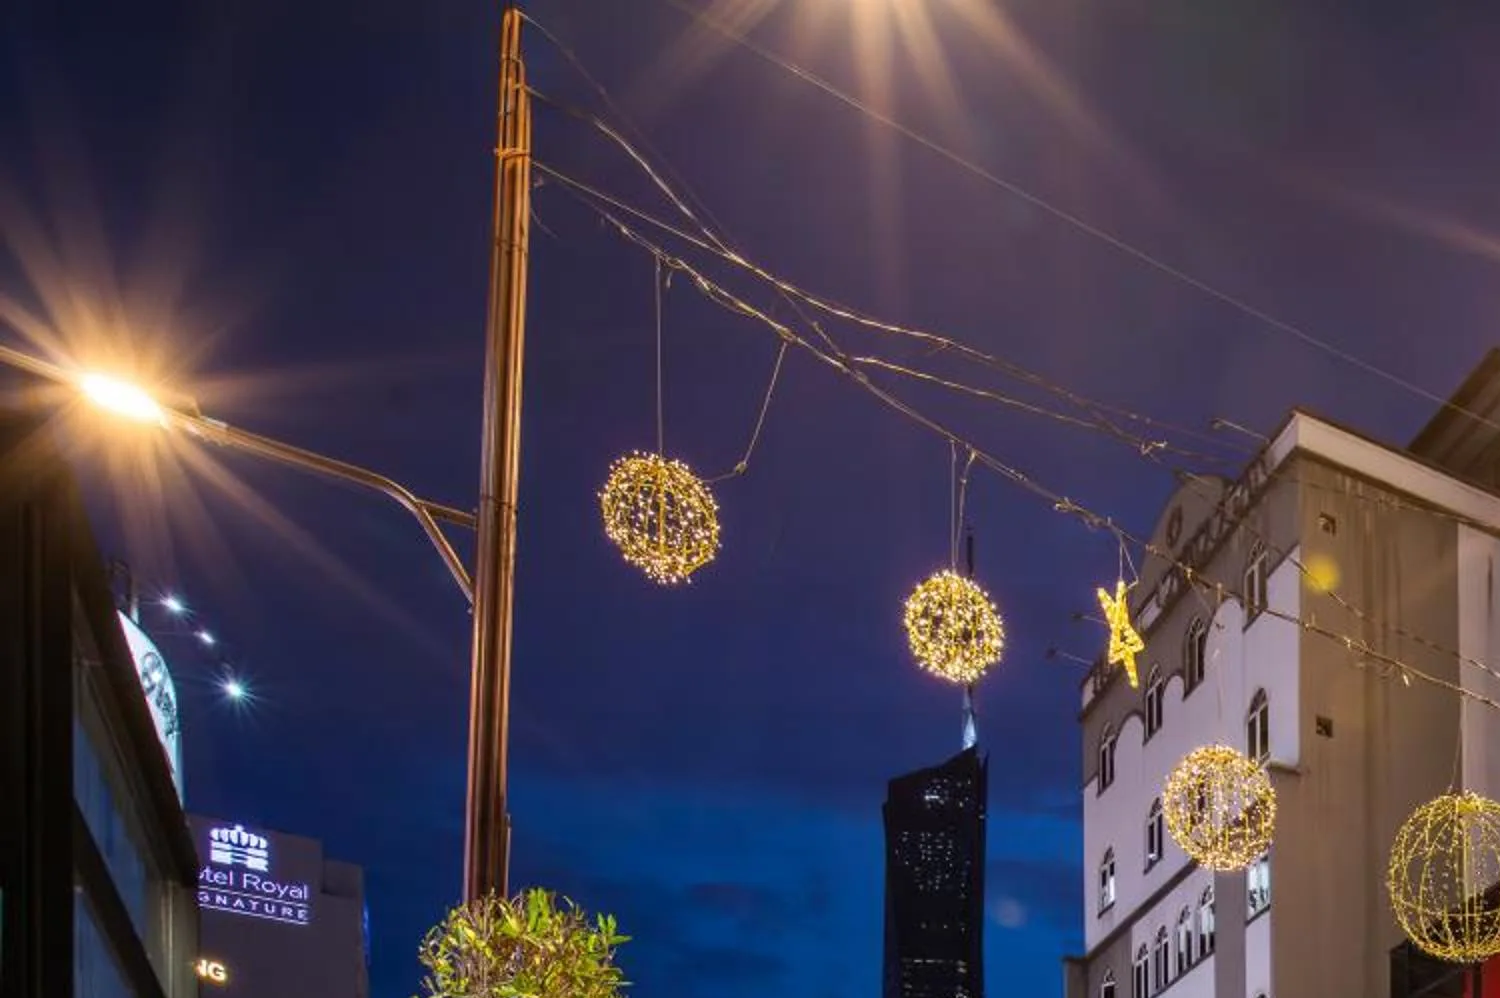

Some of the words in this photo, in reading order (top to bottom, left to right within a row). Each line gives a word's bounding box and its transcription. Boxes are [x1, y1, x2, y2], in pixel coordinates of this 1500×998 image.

[199, 867, 233, 886] tel
[243, 872, 309, 901] Royal
[199, 891, 309, 921] GNATURE
